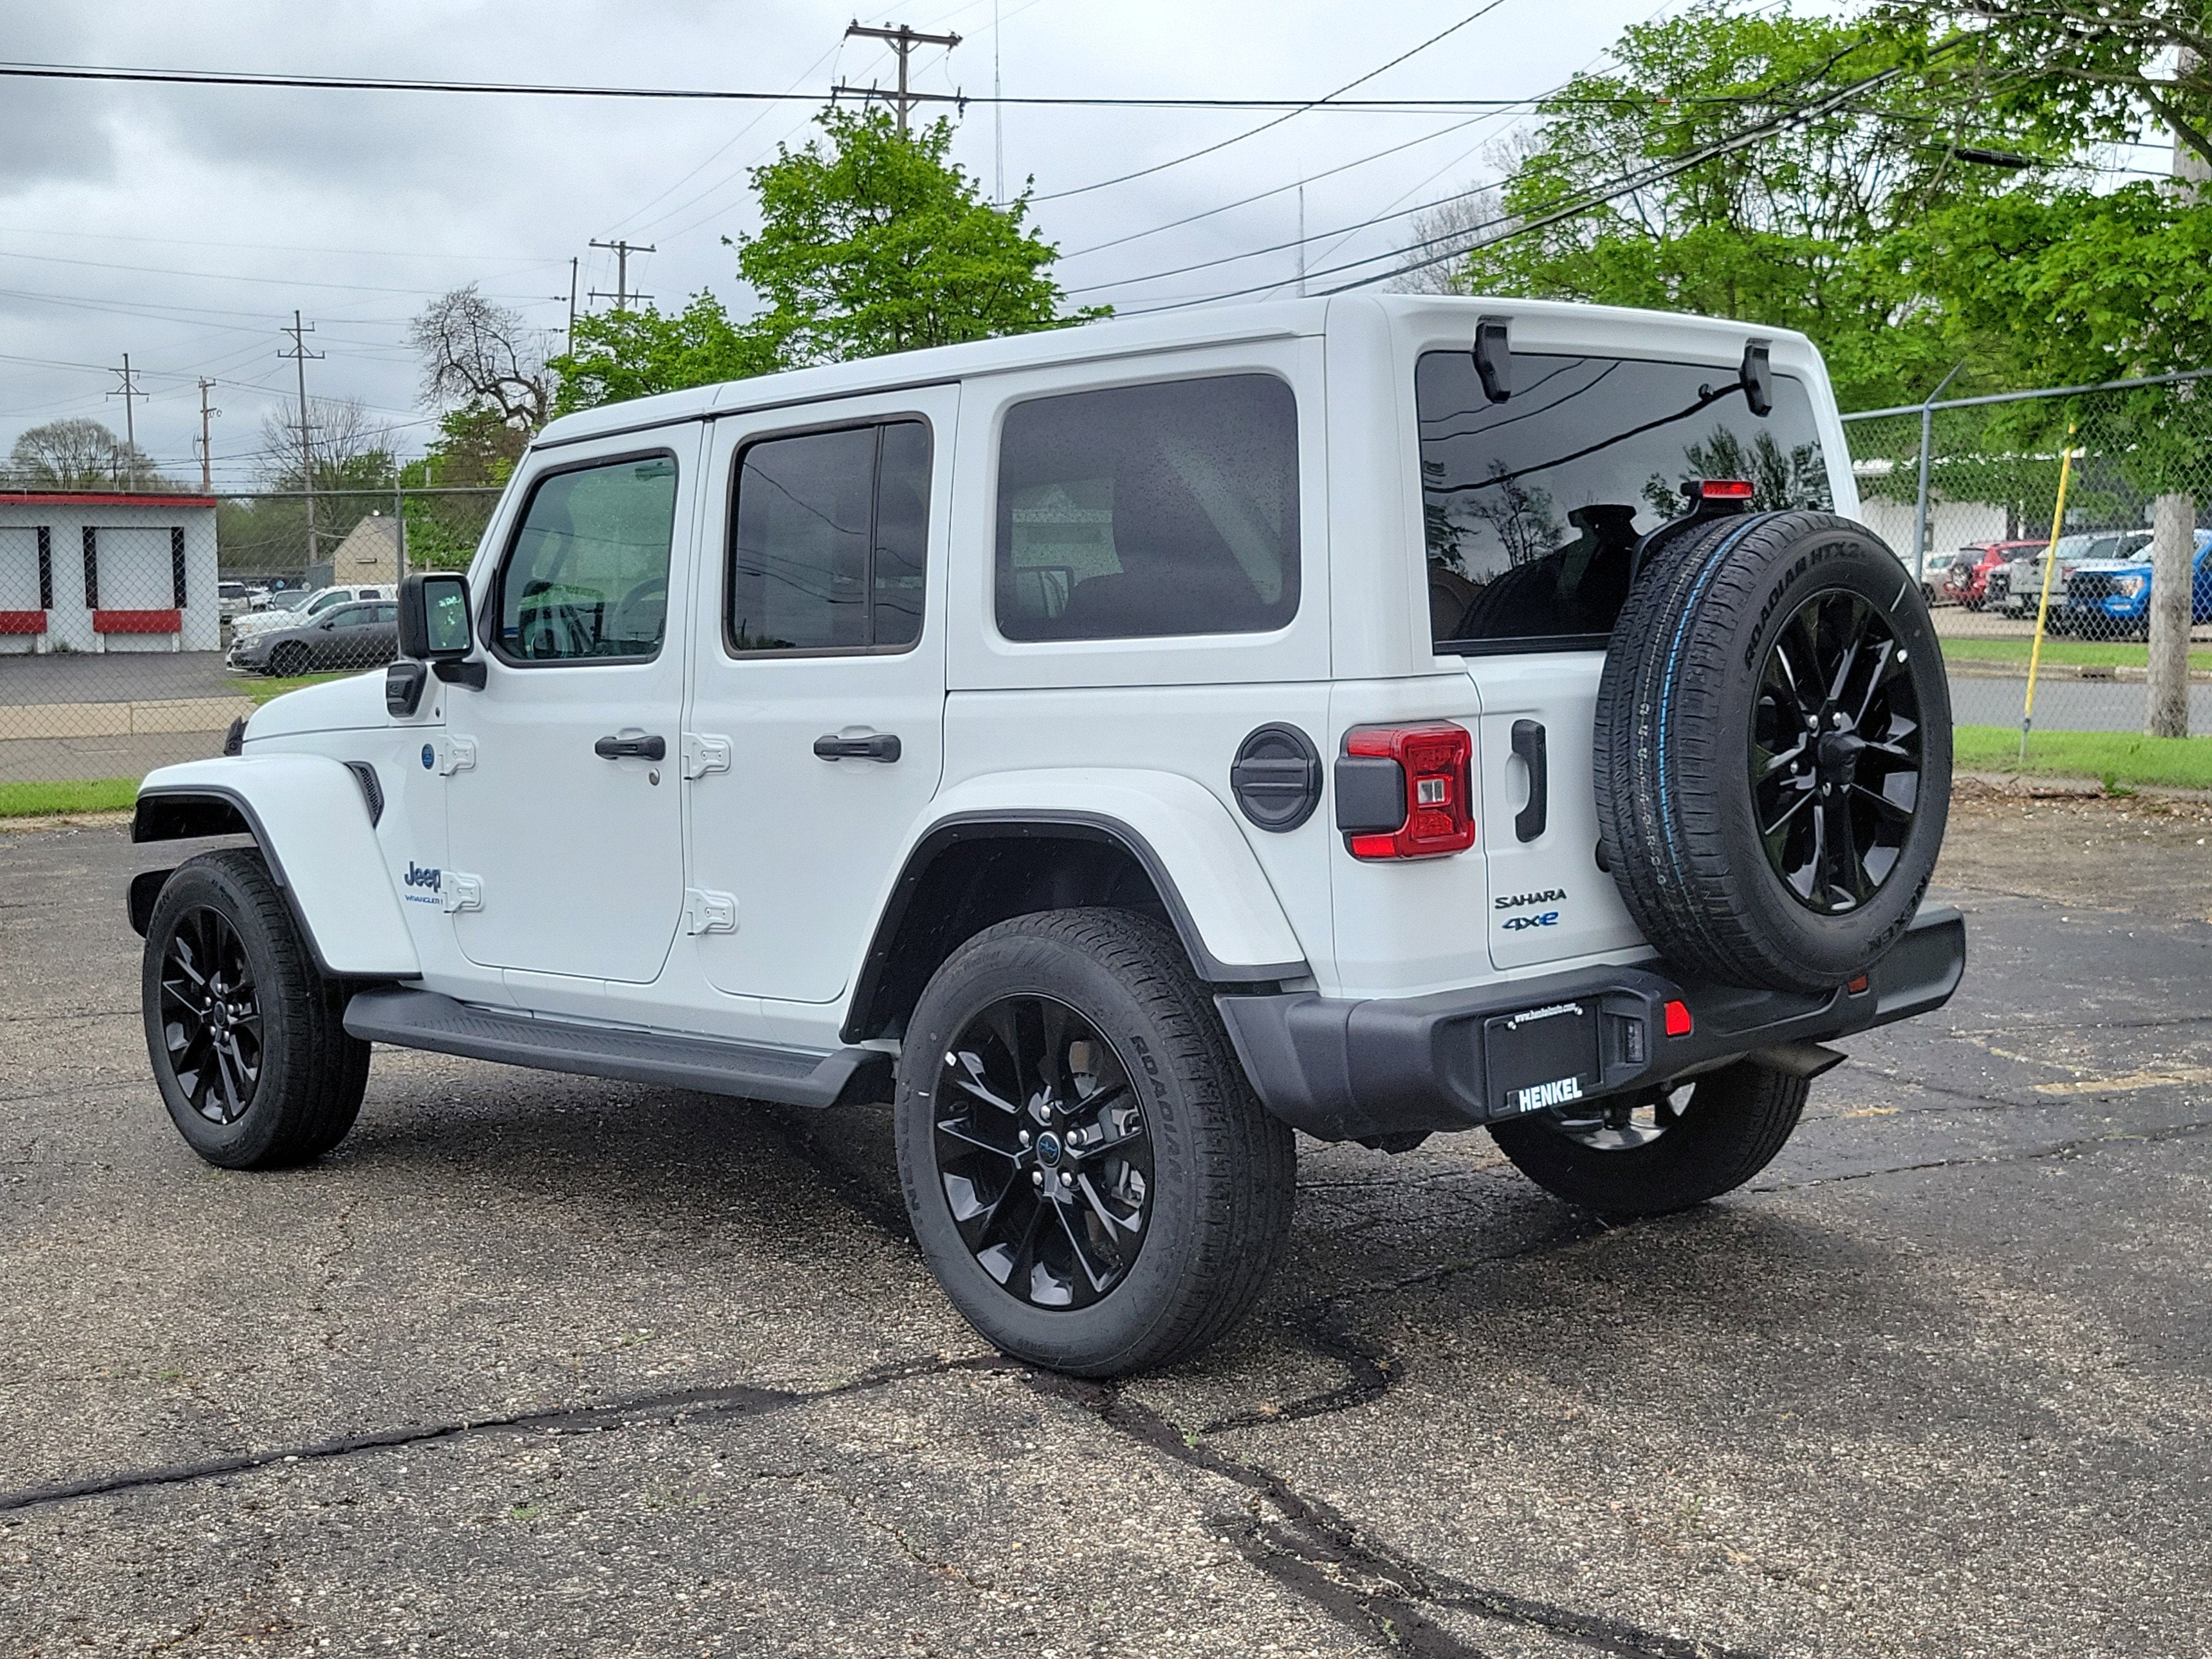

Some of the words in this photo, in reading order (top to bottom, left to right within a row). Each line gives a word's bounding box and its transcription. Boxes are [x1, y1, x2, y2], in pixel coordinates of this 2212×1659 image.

[1744, 555, 1808, 671] ROADIAN
[404, 861, 441, 893] Jeep
[405, 894, 440, 905] WRANGLER
[1494, 888, 1567, 910] SAHARA
[1131, 1035, 1182, 1183] ROADIAN
[1519, 1077, 1583, 1112] HENKEL
